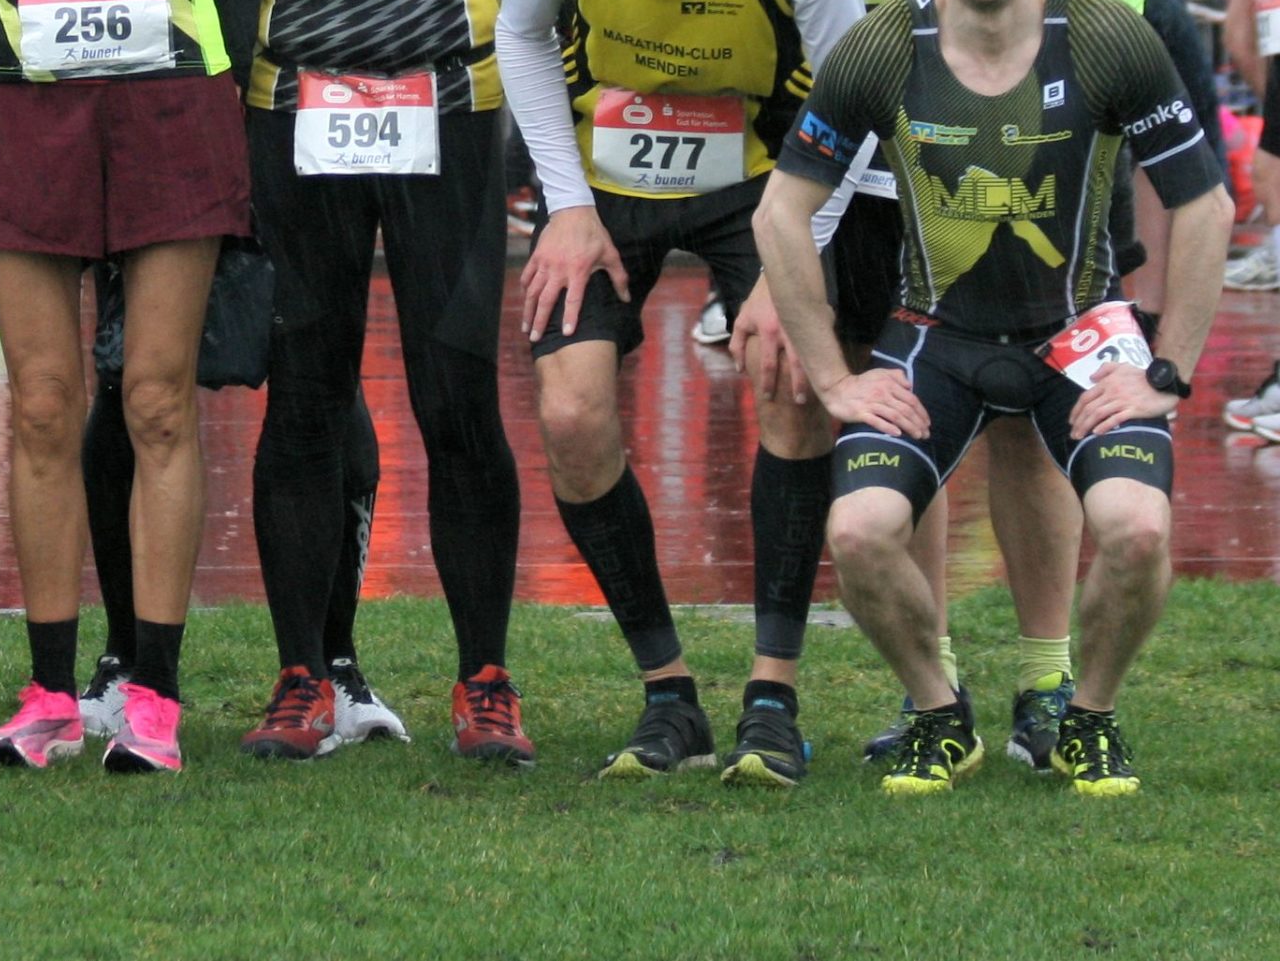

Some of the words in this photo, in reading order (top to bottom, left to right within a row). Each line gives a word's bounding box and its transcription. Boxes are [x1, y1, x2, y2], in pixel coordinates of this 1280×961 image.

[54, 4, 132, 44] 256
[81, 46, 122, 60] bunert
[603, 28, 733, 60] MARATHON-CLUB
[635, 54, 699, 77] MENDEN
[327, 111, 401, 148] 594
[1121, 100, 1184, 137] ranke
[351, 152, 392, 164] bunert
[629, 133, 706, 170] 277
[654, 174, 696, 186] bunert
[847, 452, 900, 472] MCM
[1100, 444, 1154, 465] MCM
